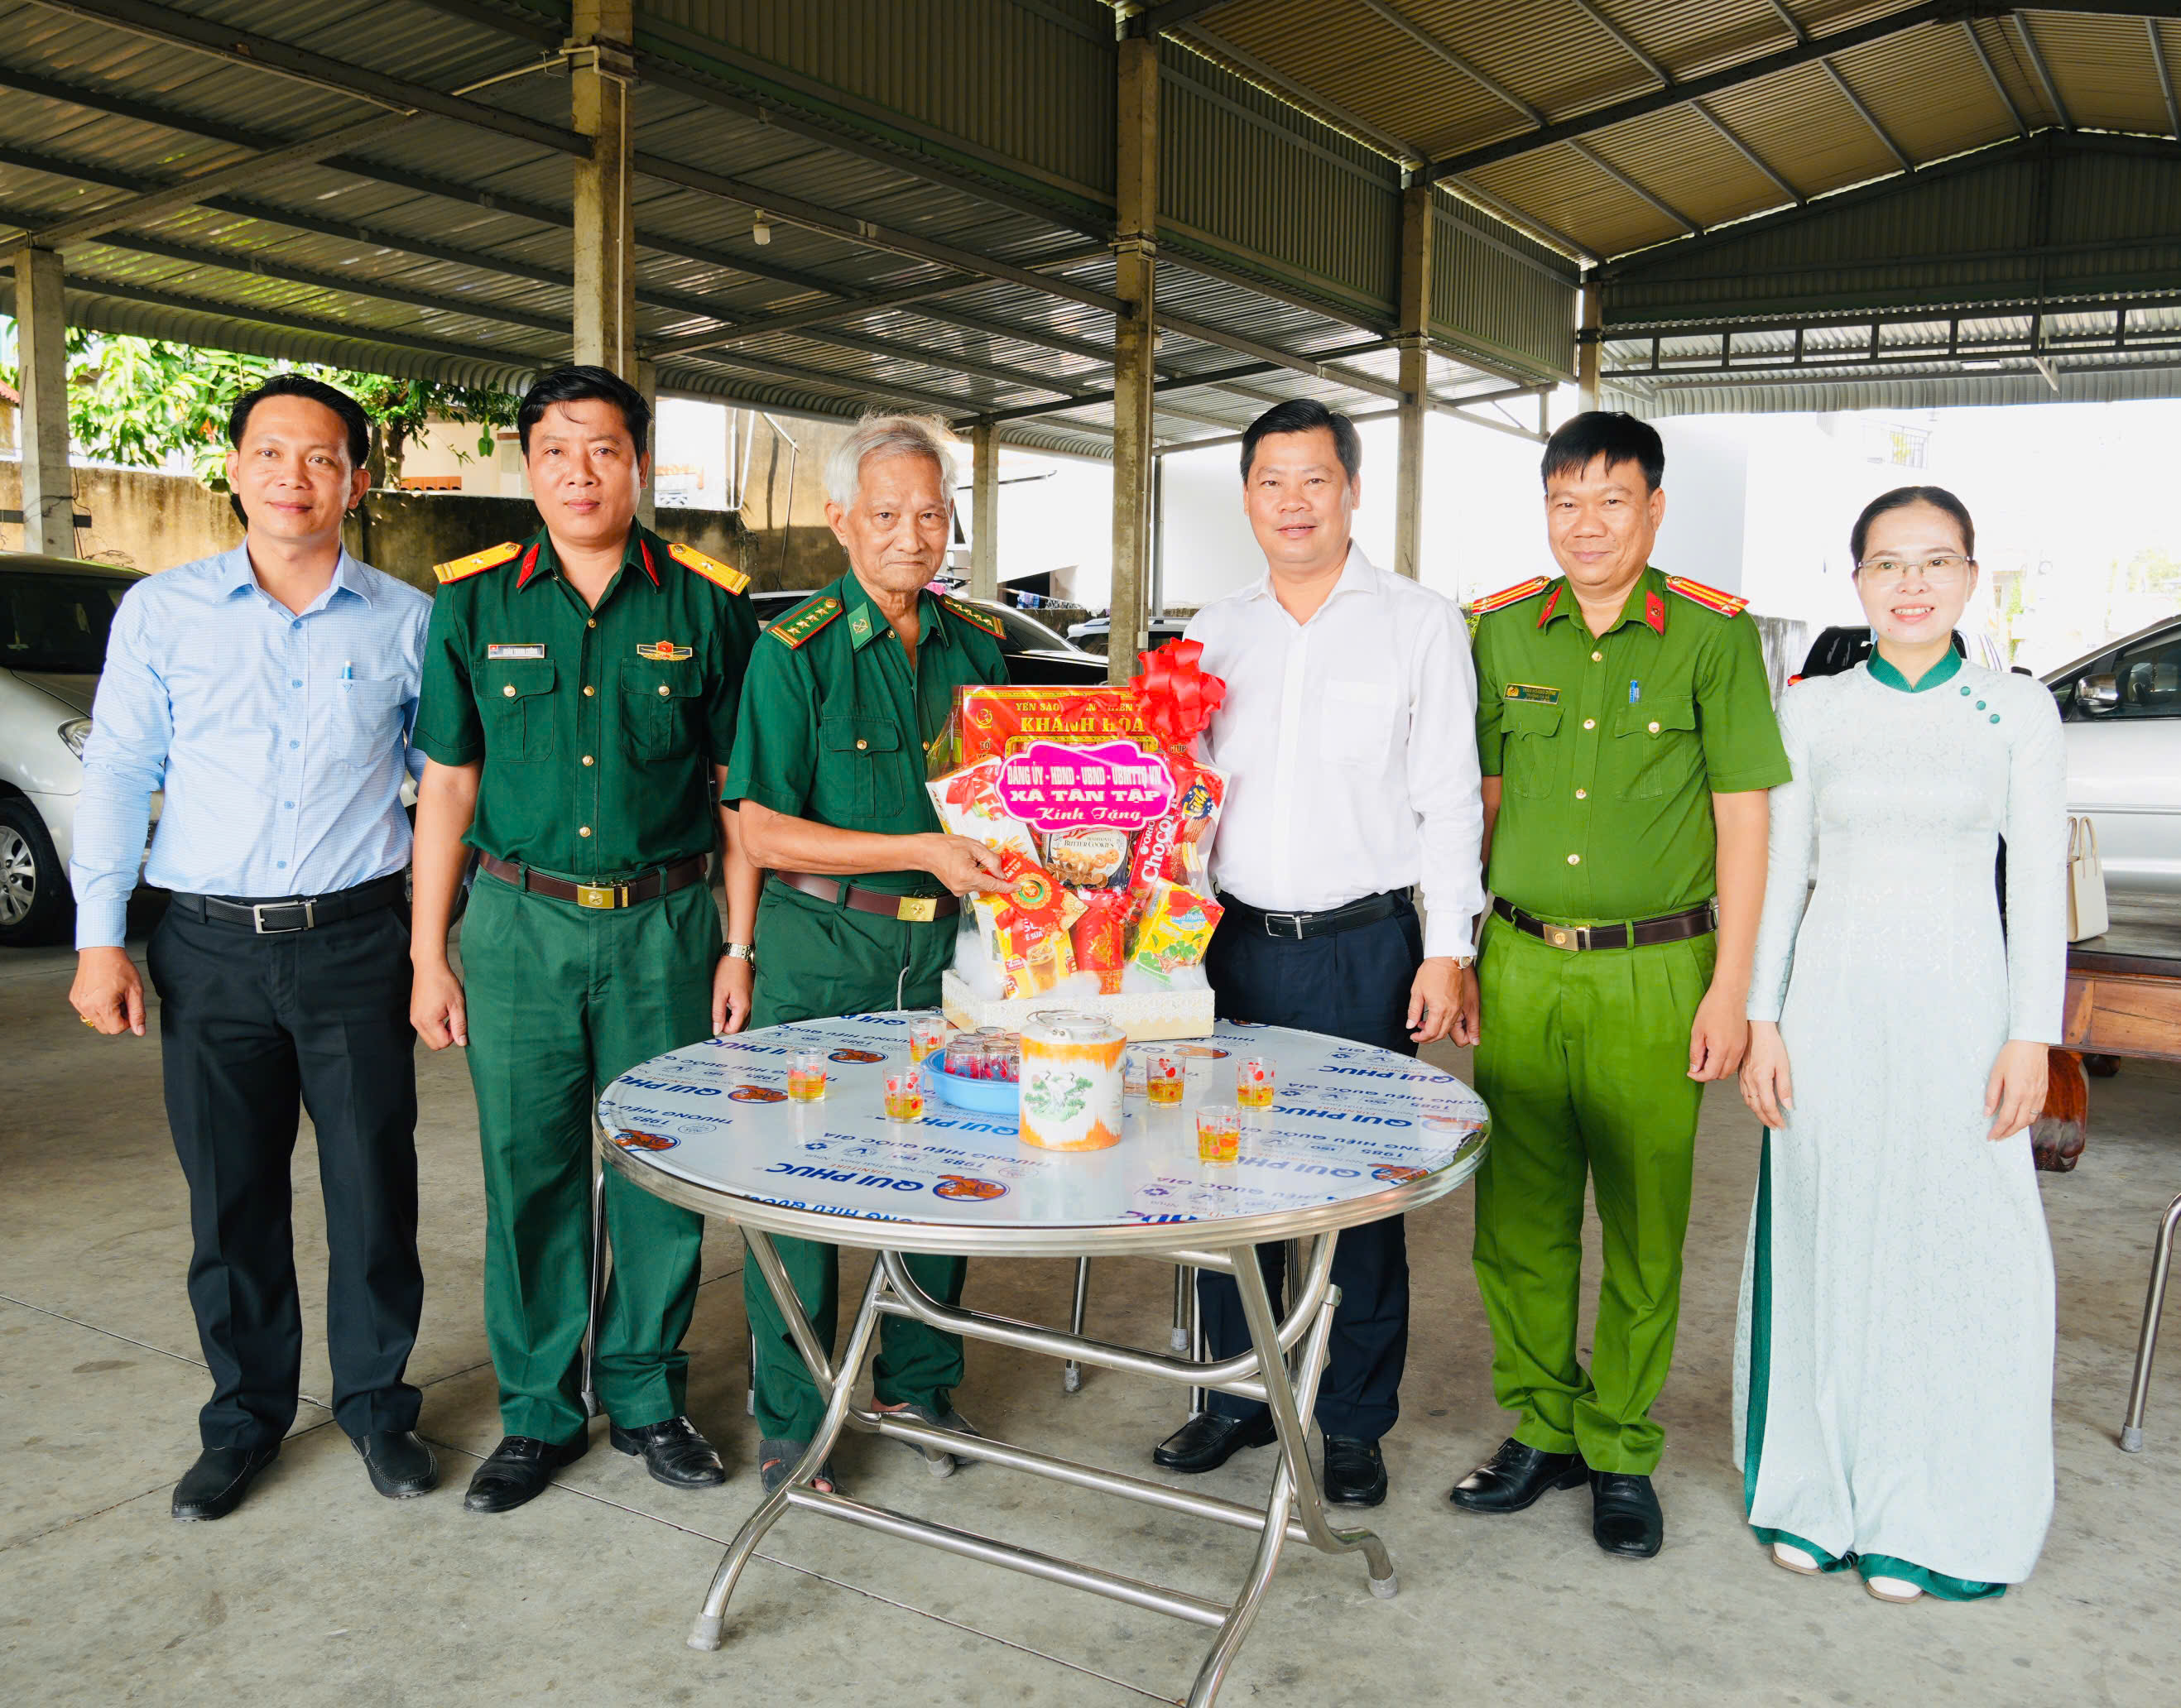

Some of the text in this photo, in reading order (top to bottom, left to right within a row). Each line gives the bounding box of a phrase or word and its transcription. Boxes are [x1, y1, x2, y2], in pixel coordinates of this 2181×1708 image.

[1020, 714, 1146, 732] KHÁNH HÒA
[1080, 765, 1106, 785] UBND
[1010, 789, 1045, 802] XÃ
[1050, 789, 1105, 802] TÂN
[1091, 807, 1142, 822] Tặng
[1143, 820, 1155, 844] ORIO
[857, 1015, 906, 1026] QUI
[1318, 1065, 1396, 1078] PHUC
[1399, 1073, 1455, 1084] QUI
[613, 1075, 669, 1090] PHU
[663, 1085, 723, 1096] QUI
[1267, 1106, 1413, 1127] QUI PHUC
[958, 1123, 1020, 1136] QUI
[764, 1163, 925, 1192] QUI PHUC
[1293, 1163, 1362, 1178] QUI
